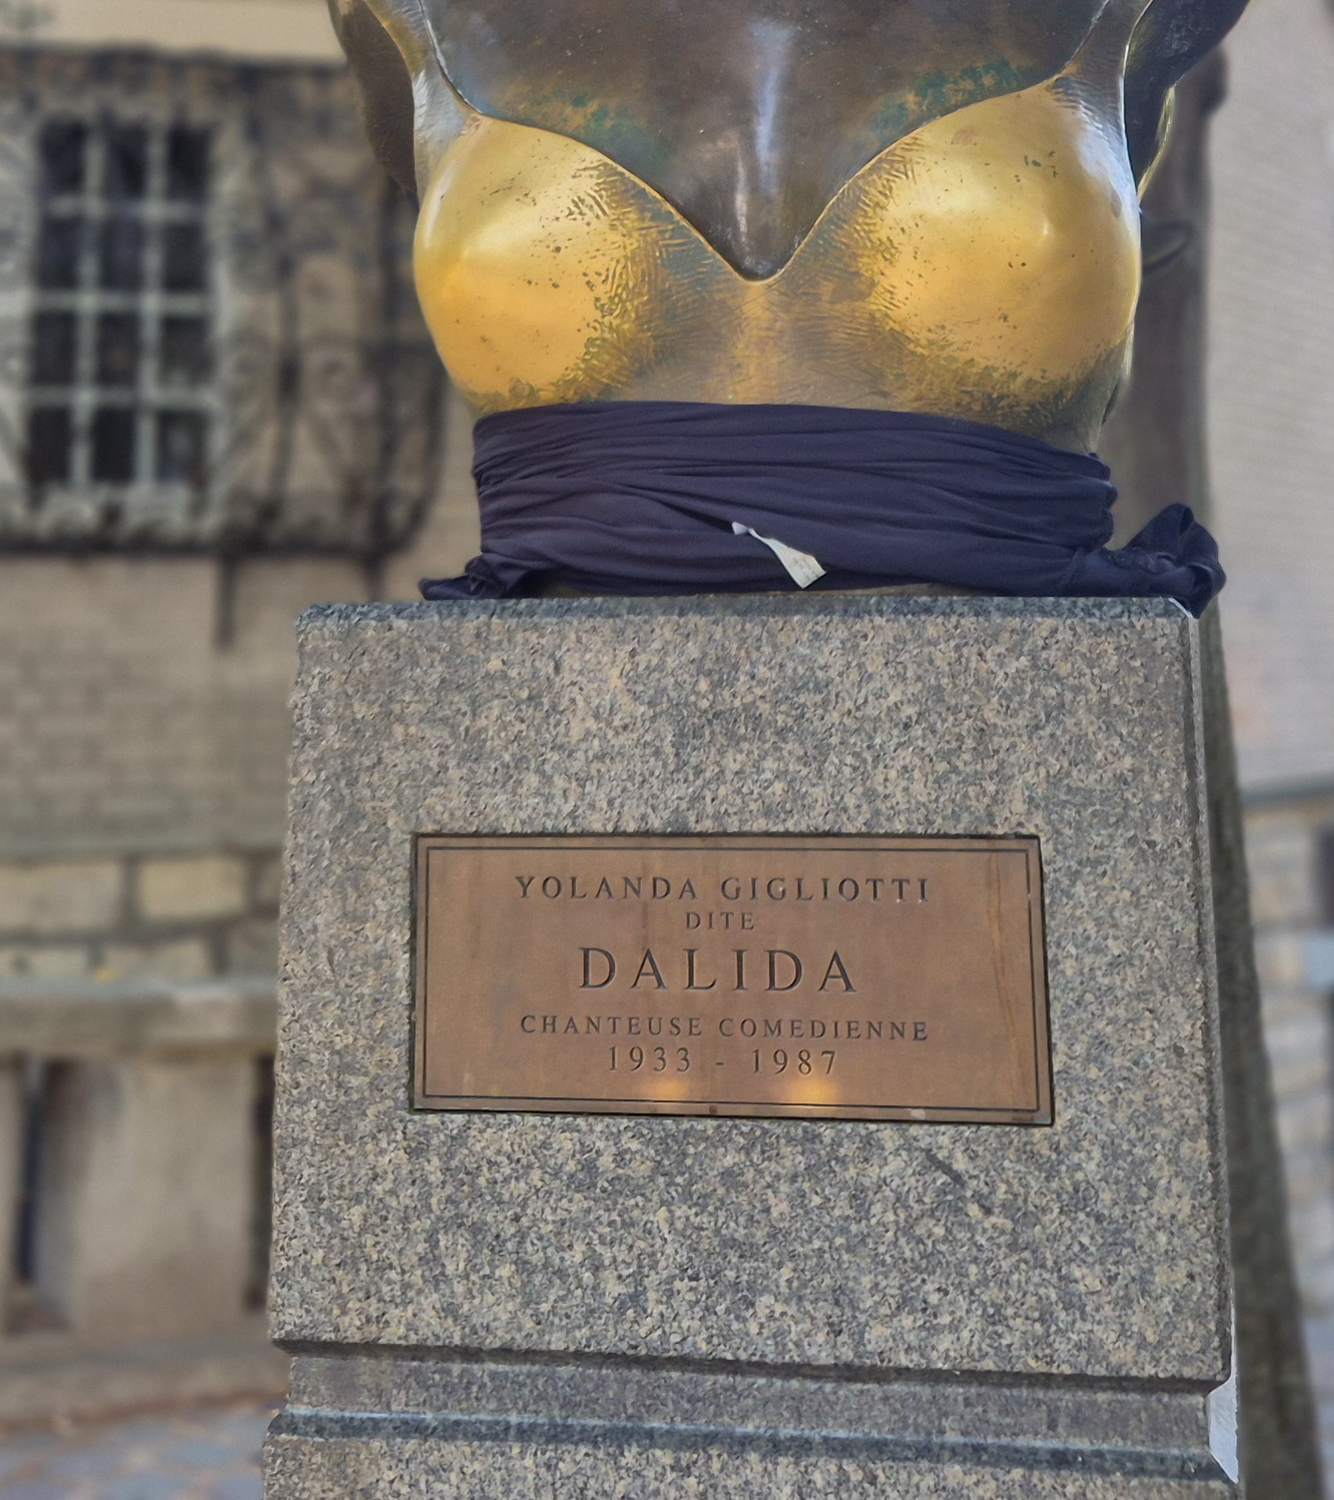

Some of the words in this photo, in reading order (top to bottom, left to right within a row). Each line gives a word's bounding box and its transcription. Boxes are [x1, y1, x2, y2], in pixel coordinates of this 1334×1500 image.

[514, 875, 699, 901] YOLANDA
[720, 876, 930, 903] GIGLIOTTI
[684, 911, 756, 931] DITE
[577, 946, 858, 993] DALIDA
[520, 1014, 704, 1037] CHANTEUSE
[718, 1017, 930, 1042] COMEDIENNE
[607, 1045, 692, 1073] 1933
[751, 1048, 838, 1076] 1987
